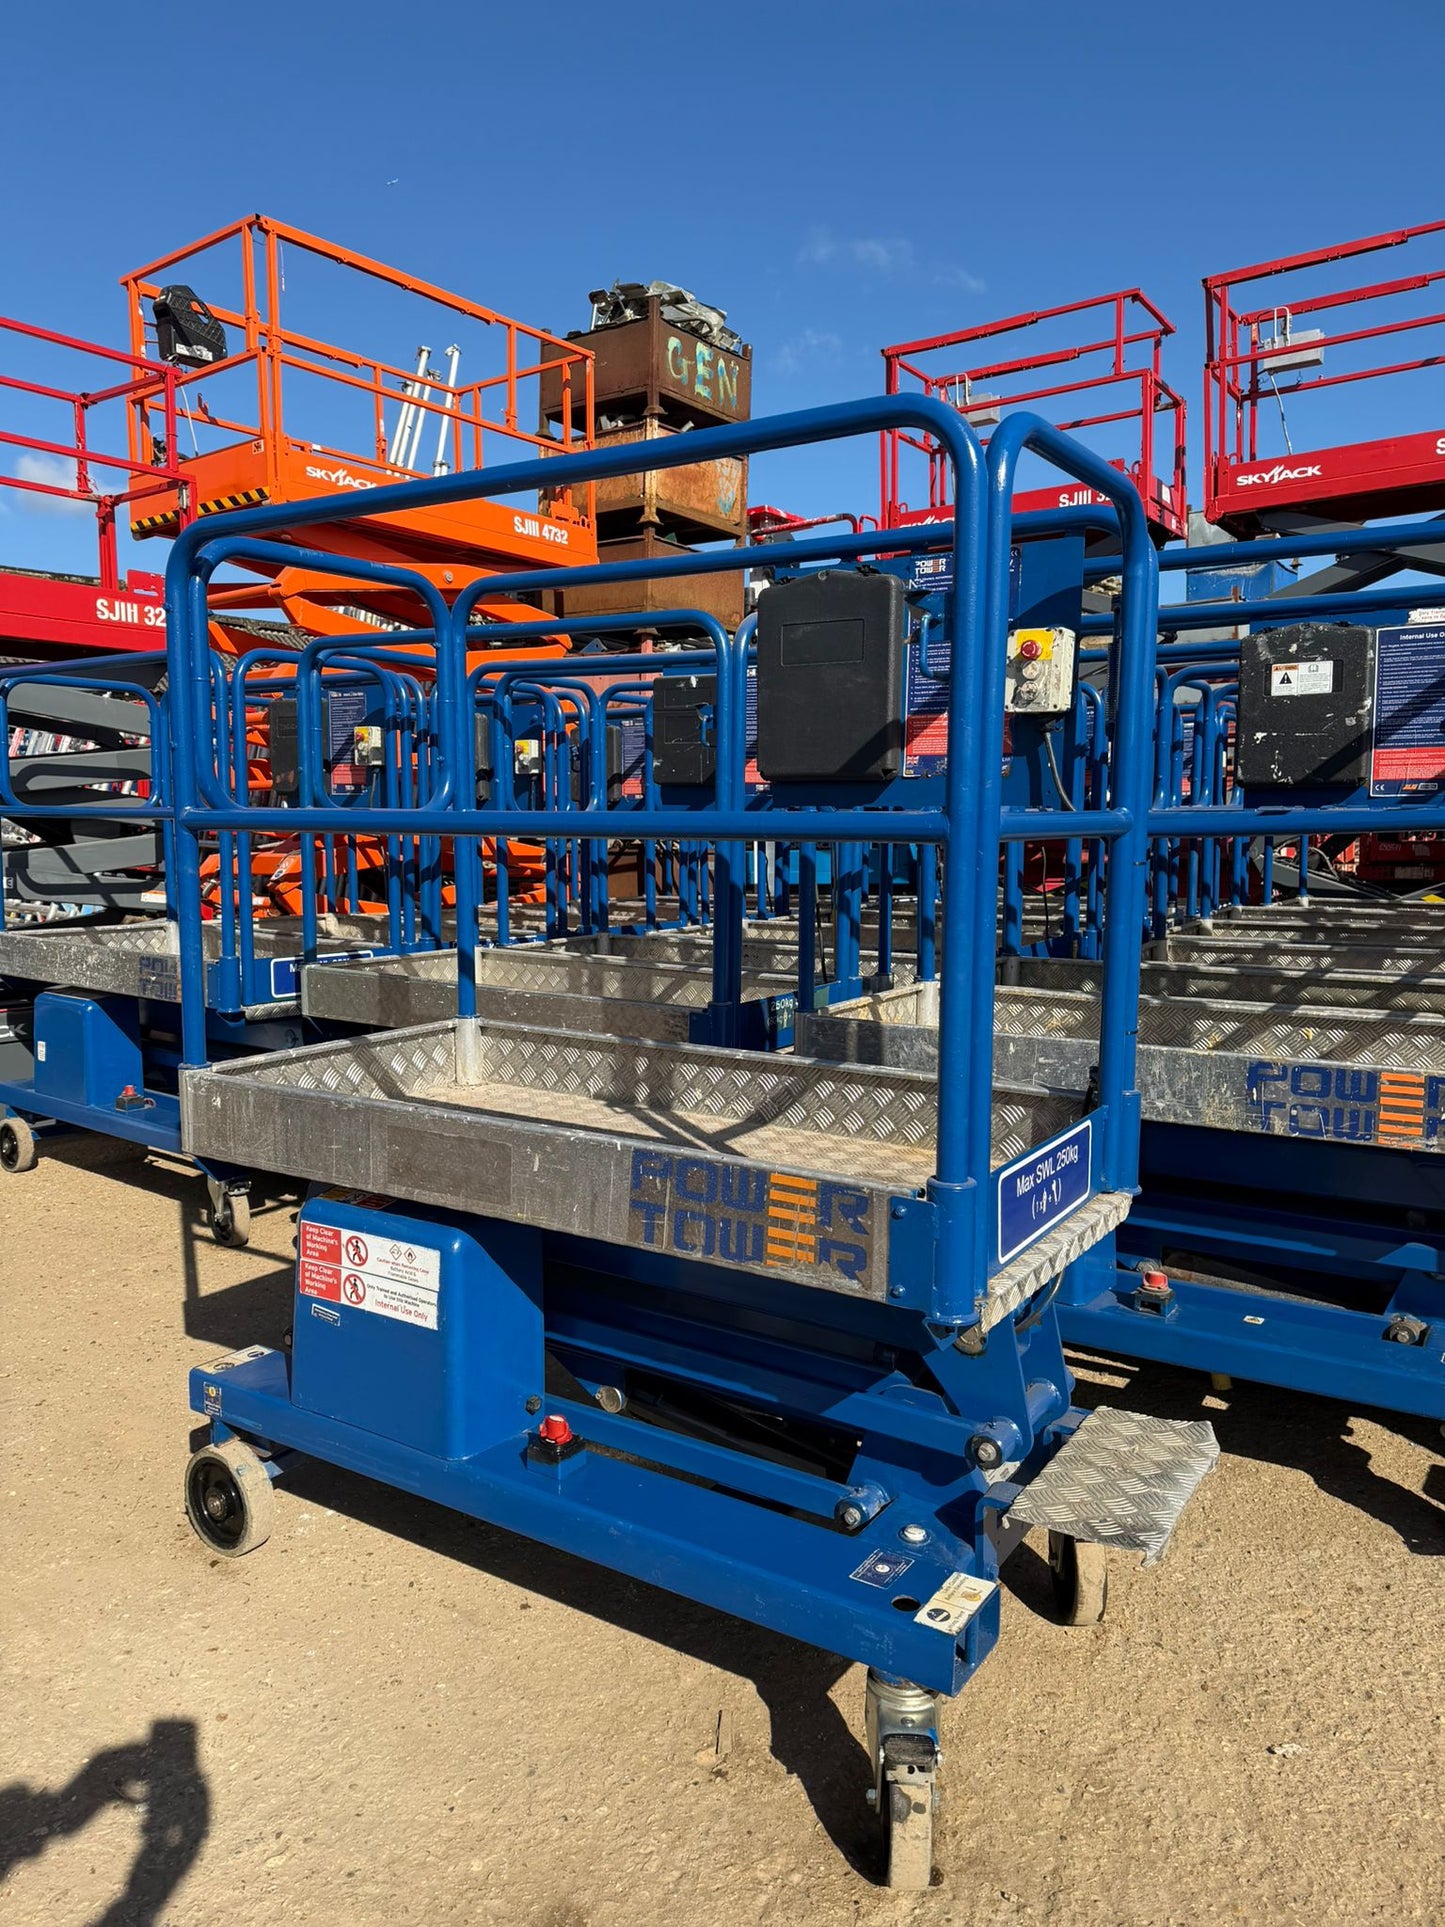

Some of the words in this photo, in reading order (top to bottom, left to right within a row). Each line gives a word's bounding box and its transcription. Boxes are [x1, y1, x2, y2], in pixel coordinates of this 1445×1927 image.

[668, 336, 739, 410] GEN
[1236, 464, 1322, 486] SKYJACK
[514, 515, 540, 538] SJIII
[542, 524, 568, 545] 4732
[1400, 632, 1425, 640] Internal
[1016, 1173, 1035, 1198] Max
[1036, 1156, 1056, 1184] SWL
[1056, 1144, 1079, 1172] 250kg
[631, 1150, 870, 1236] POWER
[306, 1225, 319, 1234] Keep
[320, 1228, 334, 1237] Clear
[306, 1242, 327, 1252] Working
[306, 1250, 319, 1258] Area
[629, 1201, 872, 1291] TOWER
[305, 1263, 318, 1272] Keep
[319, 1266, 333, 1276] Clear
[305, 1280, 326, 1290] Working
[374, 1299, 400, 1312] Internal
[400, 1306, 412, 1316] Use
[414, 1310, 428, 1322] Only
